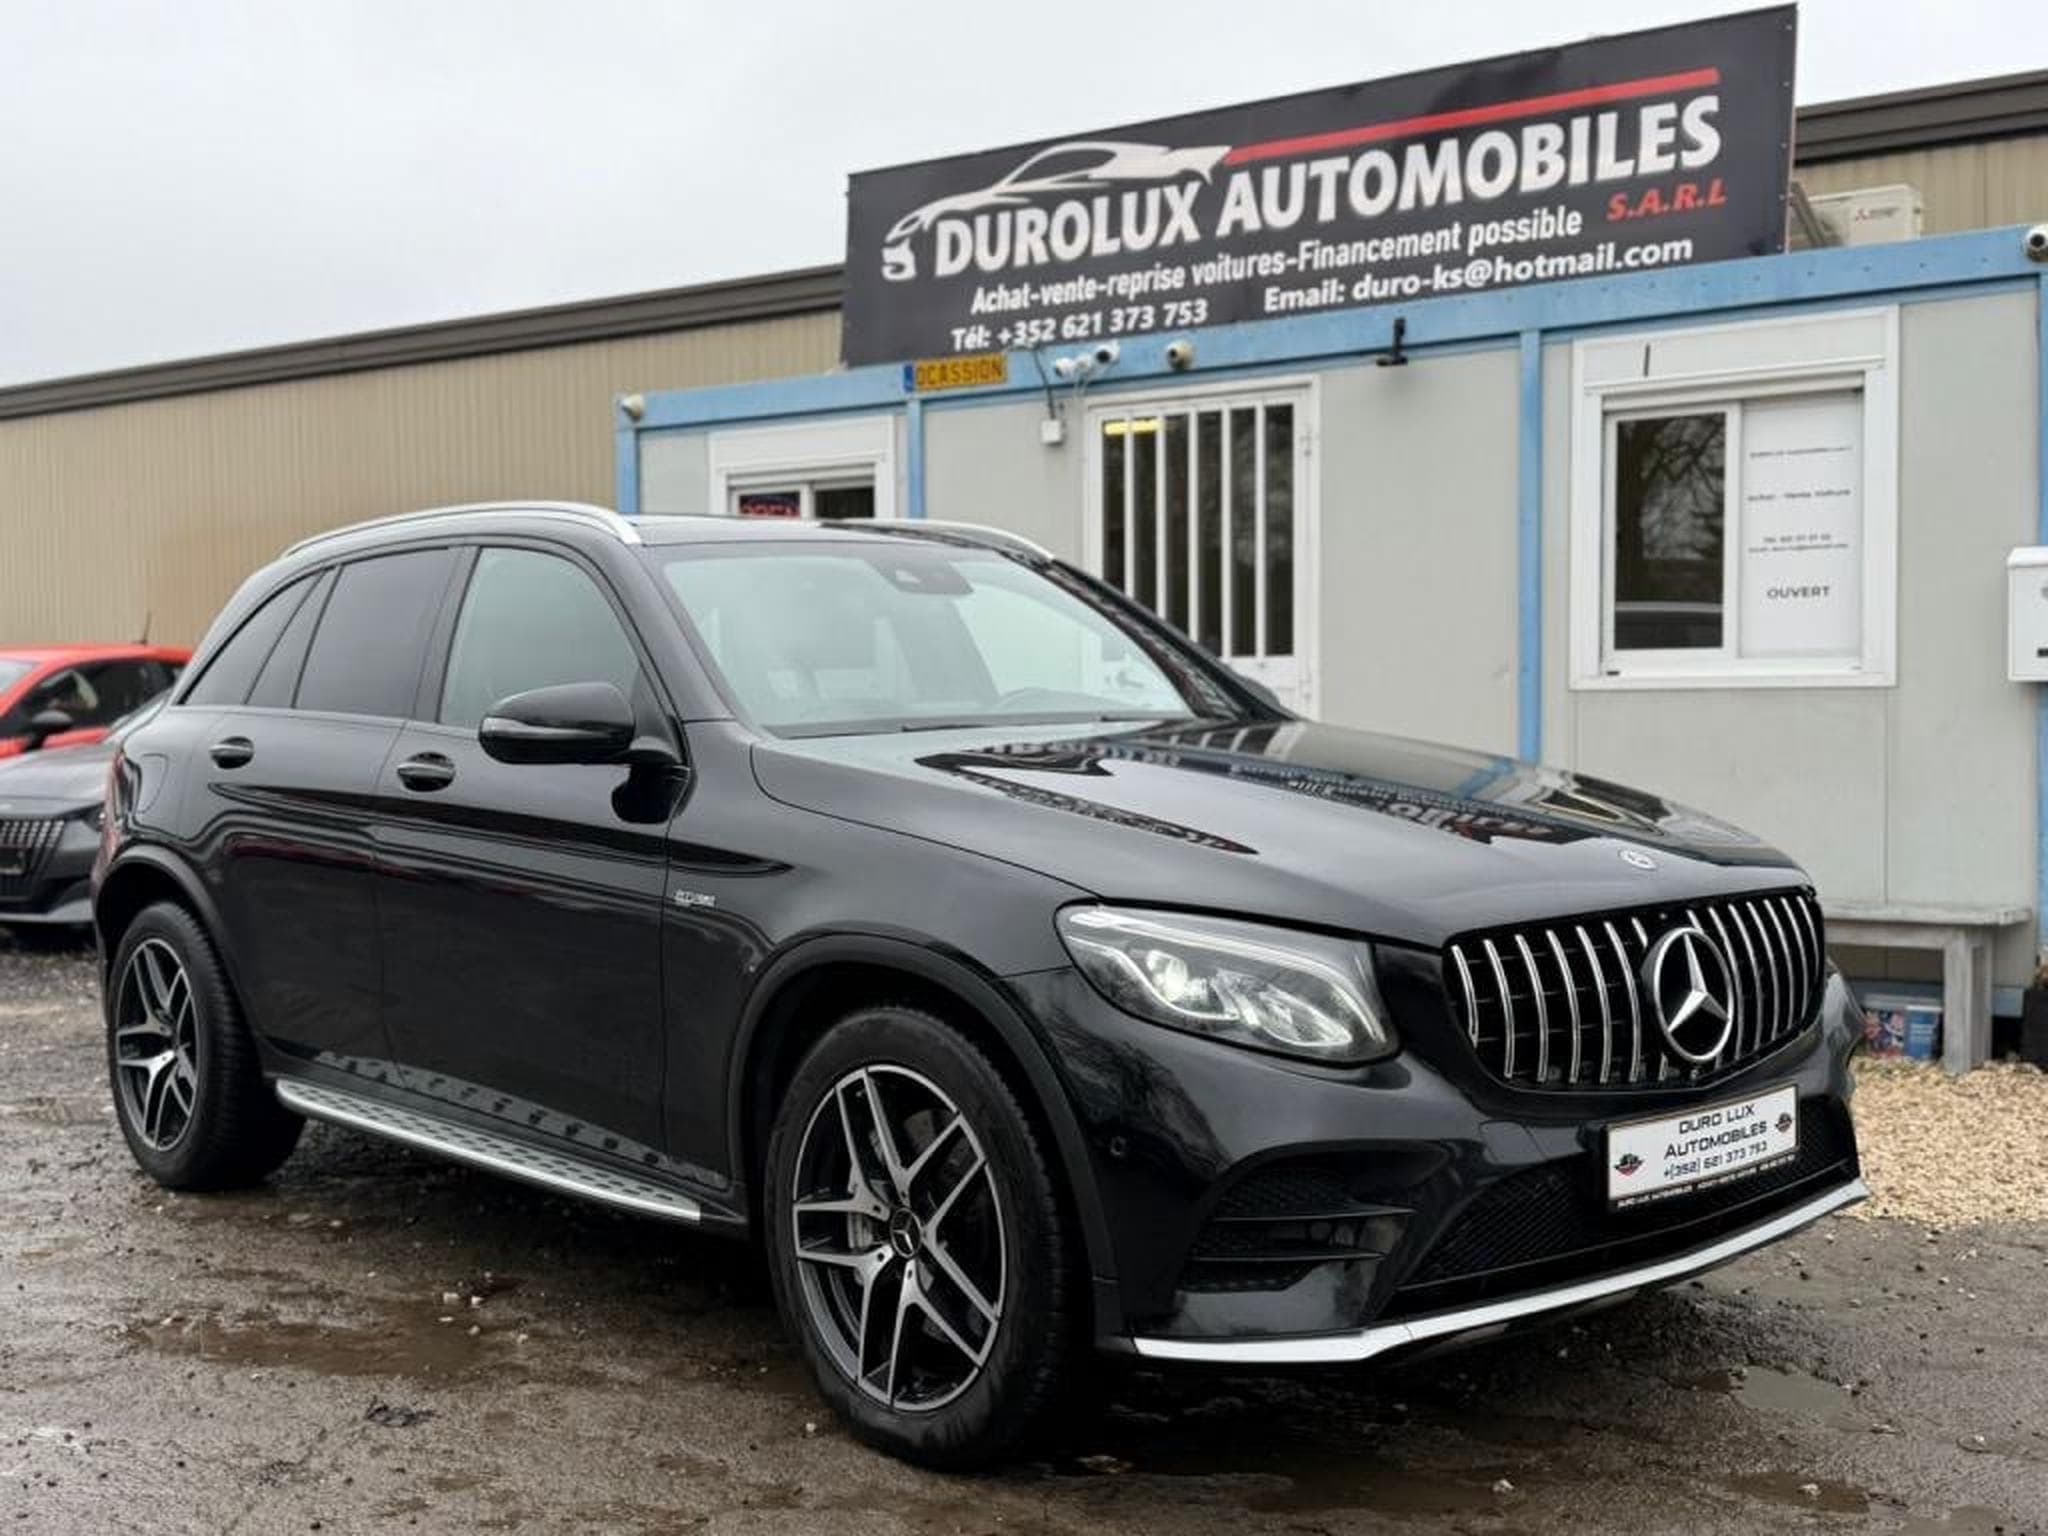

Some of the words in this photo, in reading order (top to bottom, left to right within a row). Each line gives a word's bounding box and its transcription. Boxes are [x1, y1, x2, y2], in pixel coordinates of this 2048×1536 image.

[934, 181, 1200, 276] DUROLUX
[1216, 96, 1721, 238] AUTOMOBILES
[1607, 179, 1728, 222] S.A.R.L
[970, 259, 1185, 316] Achat-vente-reprise
[1191, 221, 1463, 286] voitures-Financement
[1468, 205, 1583, 255] possible
[1264, 278, 1345, 313] Email:
[1352, 239, 1693, 302] duro-ks@hotmail.com
[951, 327, 991, 352] Tél:
[997, 317, 1056, 346] +352
[1061, 313, 1101, 340] 621
[1110, 306, 1155, 333] 373
[1163, 299, 1208, 326] 753
[1766, 585, 1831, 600] OUVERT
[1664, 1120, 1767, 1160] AUTOMOBILES
[1679, 1113, 1722, 1134] DURO
[1727, 1104, 1755, 1123] LUX
